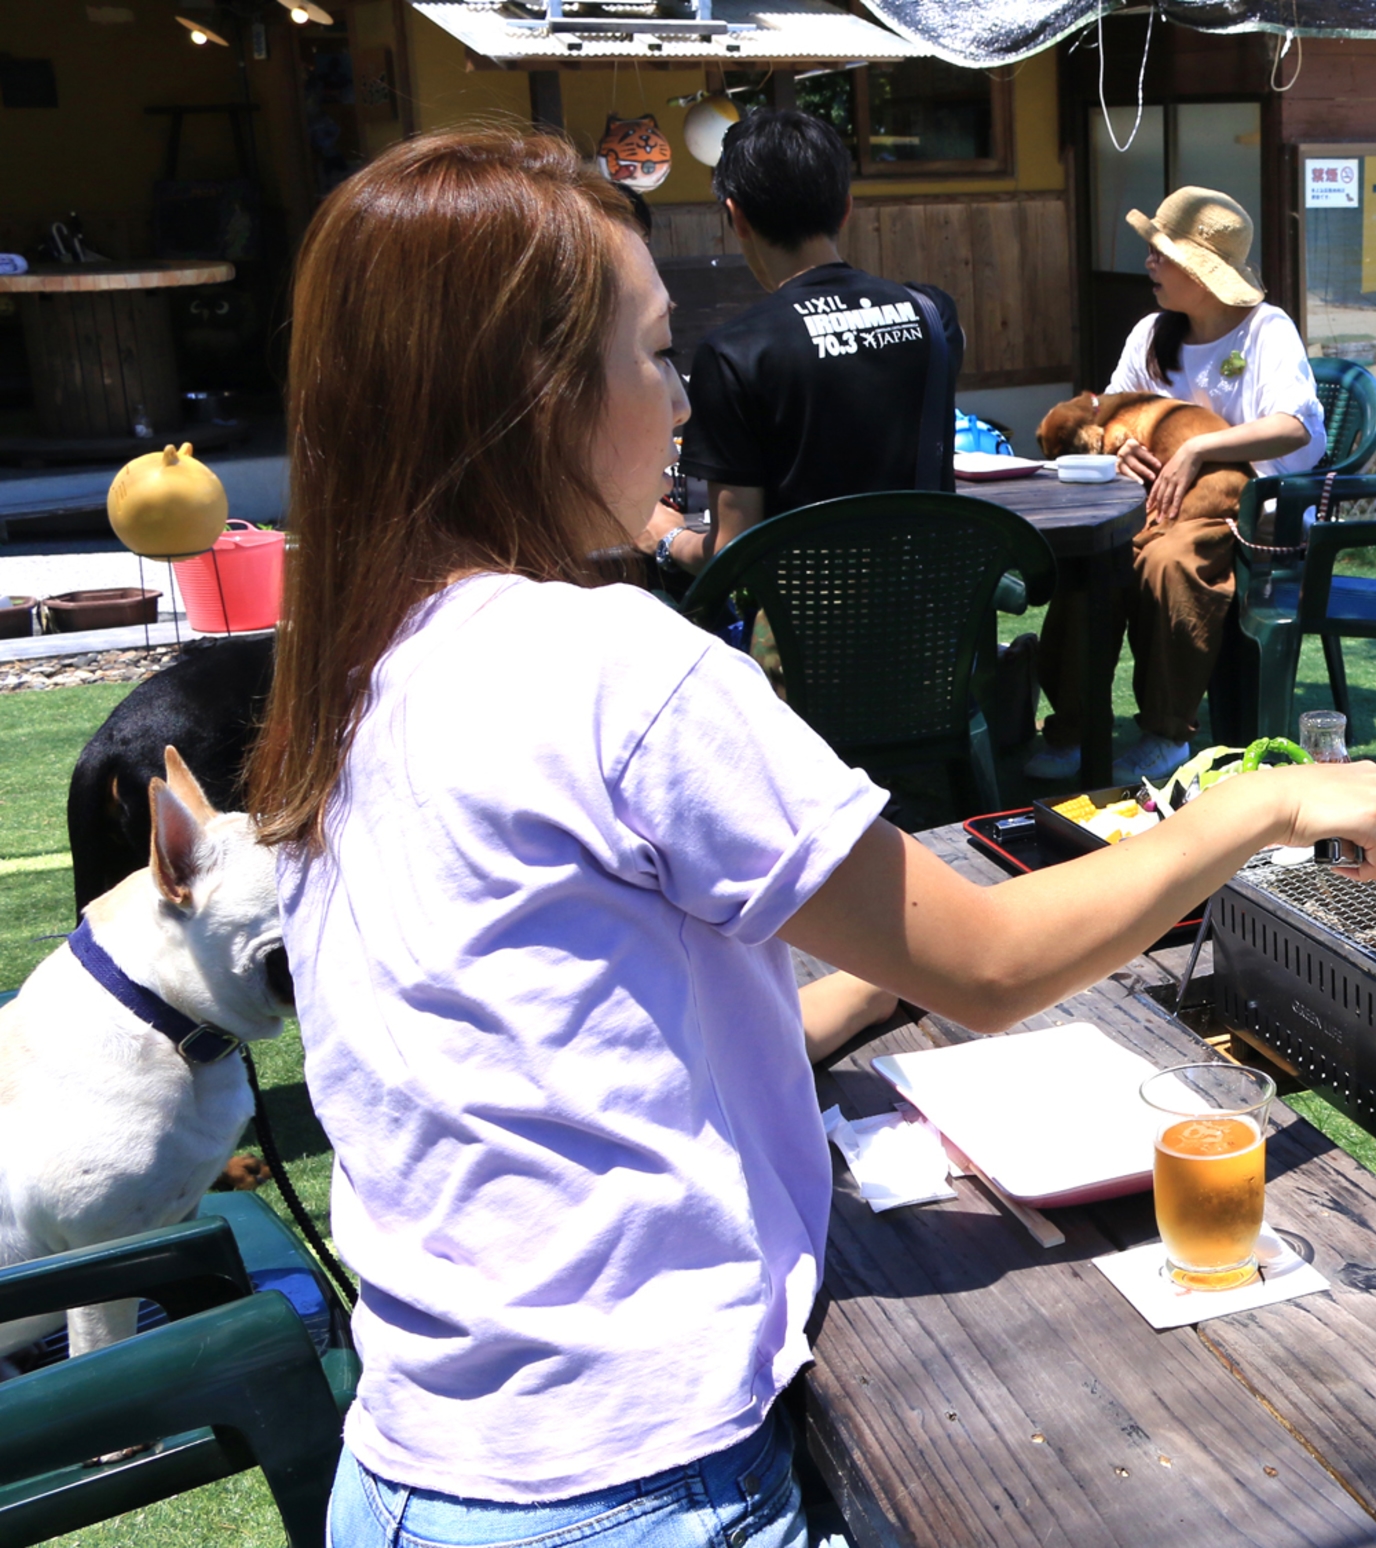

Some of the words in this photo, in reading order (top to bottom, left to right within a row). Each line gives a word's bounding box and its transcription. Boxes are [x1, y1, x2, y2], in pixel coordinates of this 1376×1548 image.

[793, 295, 848, 315] LIXIL
[803, 299, 918, 337] IRONMAN
[811, 331, 858, 359] 70.3
[877, 327, 923, 349] JAPAN
